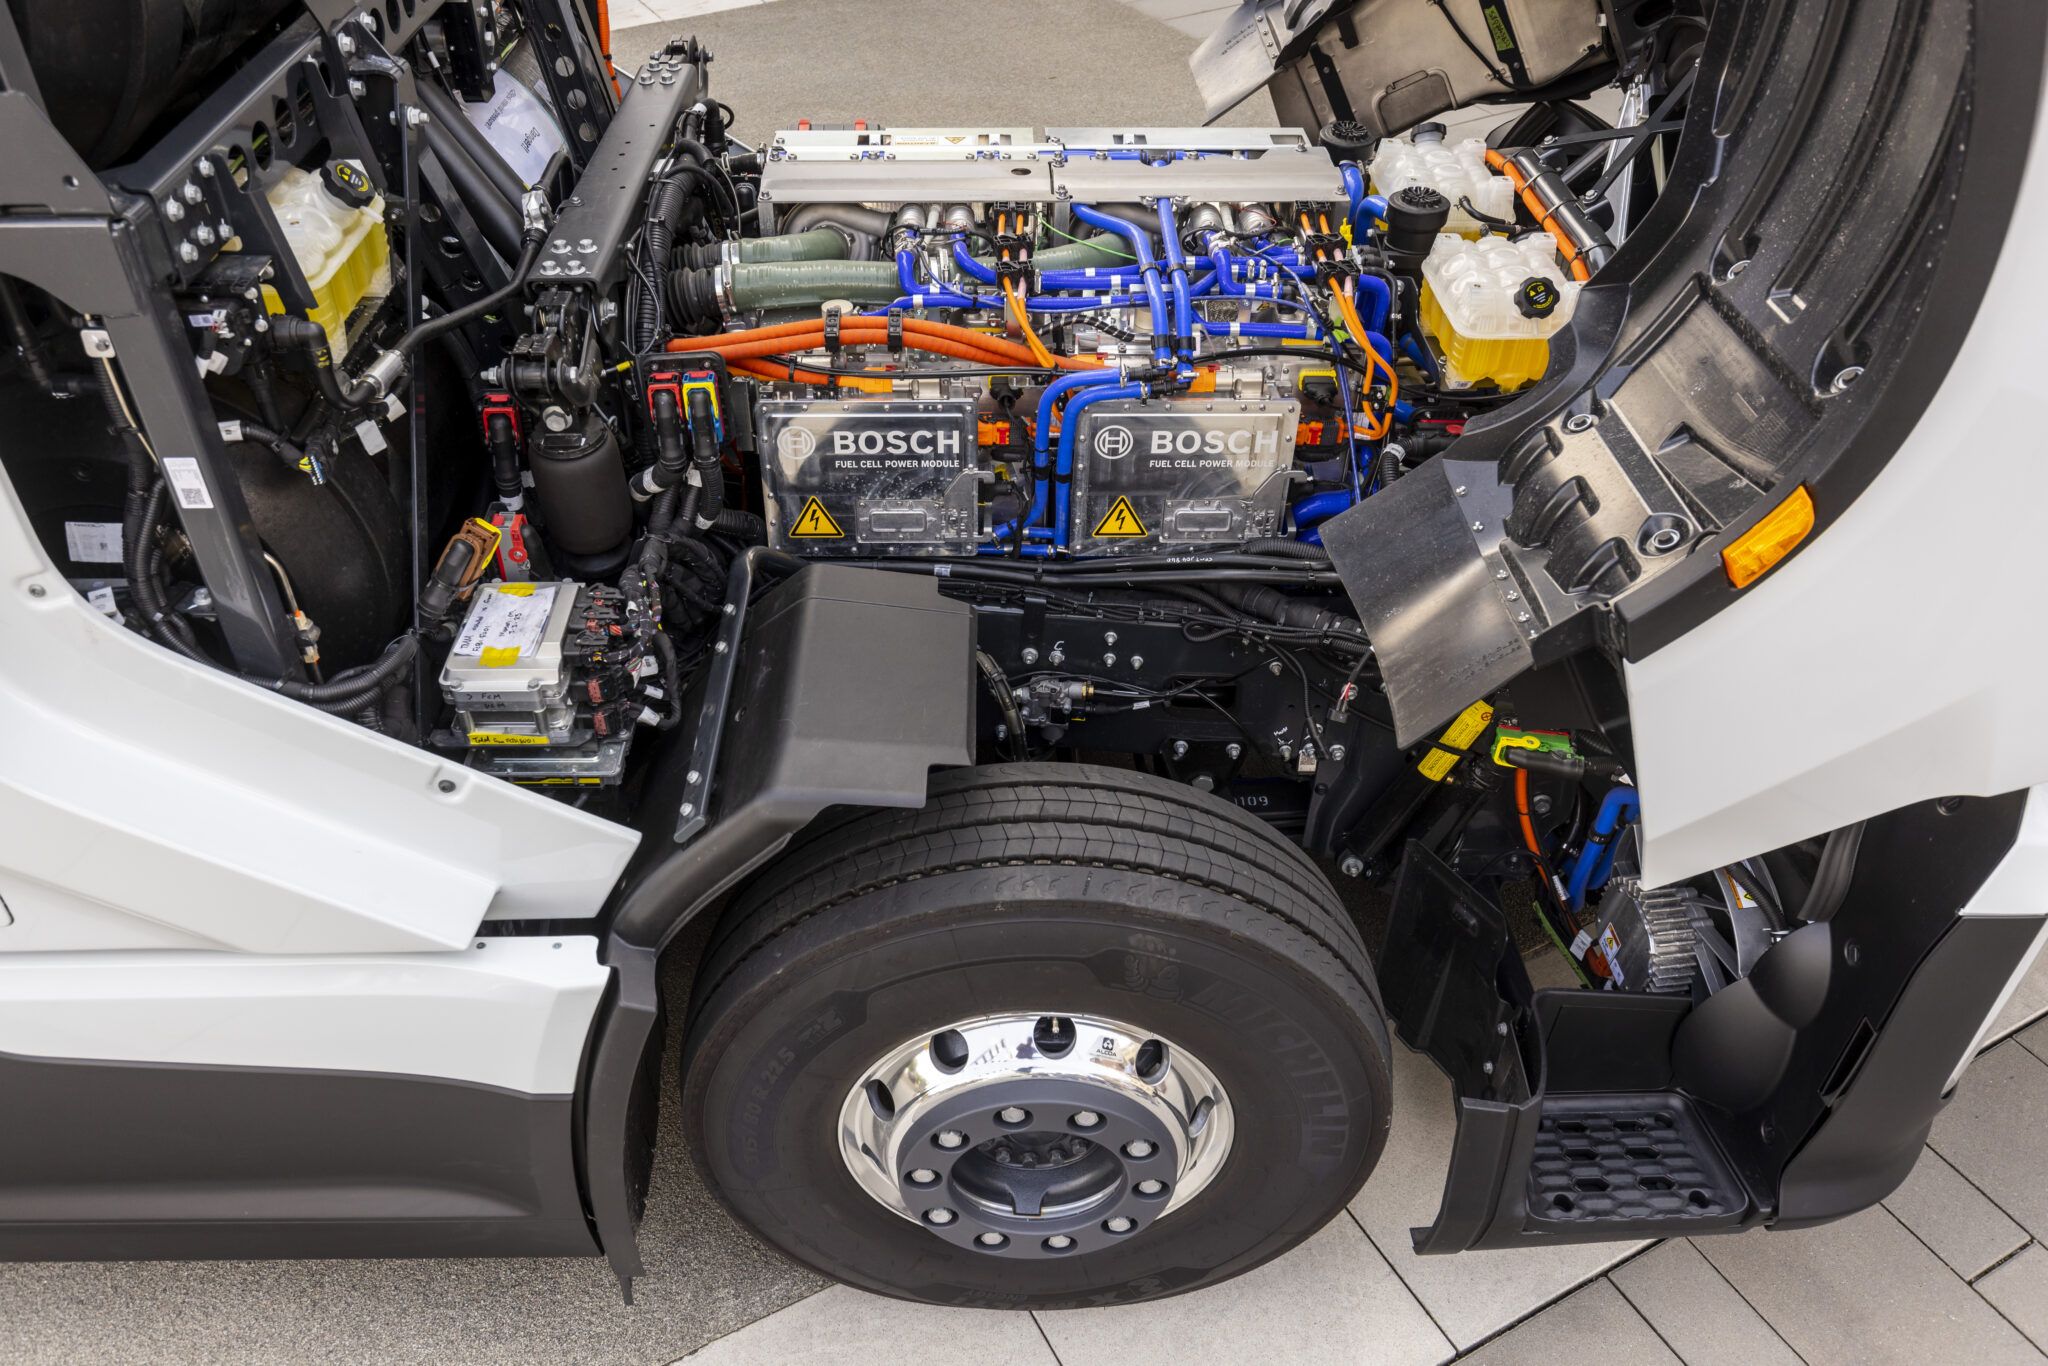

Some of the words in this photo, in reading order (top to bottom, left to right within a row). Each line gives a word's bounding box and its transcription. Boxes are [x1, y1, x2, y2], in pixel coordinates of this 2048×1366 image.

[833, 430, 961, 455] BOSCH
[1151, 430, 1279, 455] BOSCH
[835, 460, 858, 468] FUEL
[860, 460, 883, 468] CELL
[885, 460, 919, 468] POWER
[921, 460, 960, 468] MODULE
[1149, 460, 1172, 468] FUEL
[1174, 460, 1197, 468] CELL
[1199, 460, 1233, 468] POWER
[1235, 460, 1275, 468] MODULE
[1096, 1048, 1117, 1057] ALCOA
